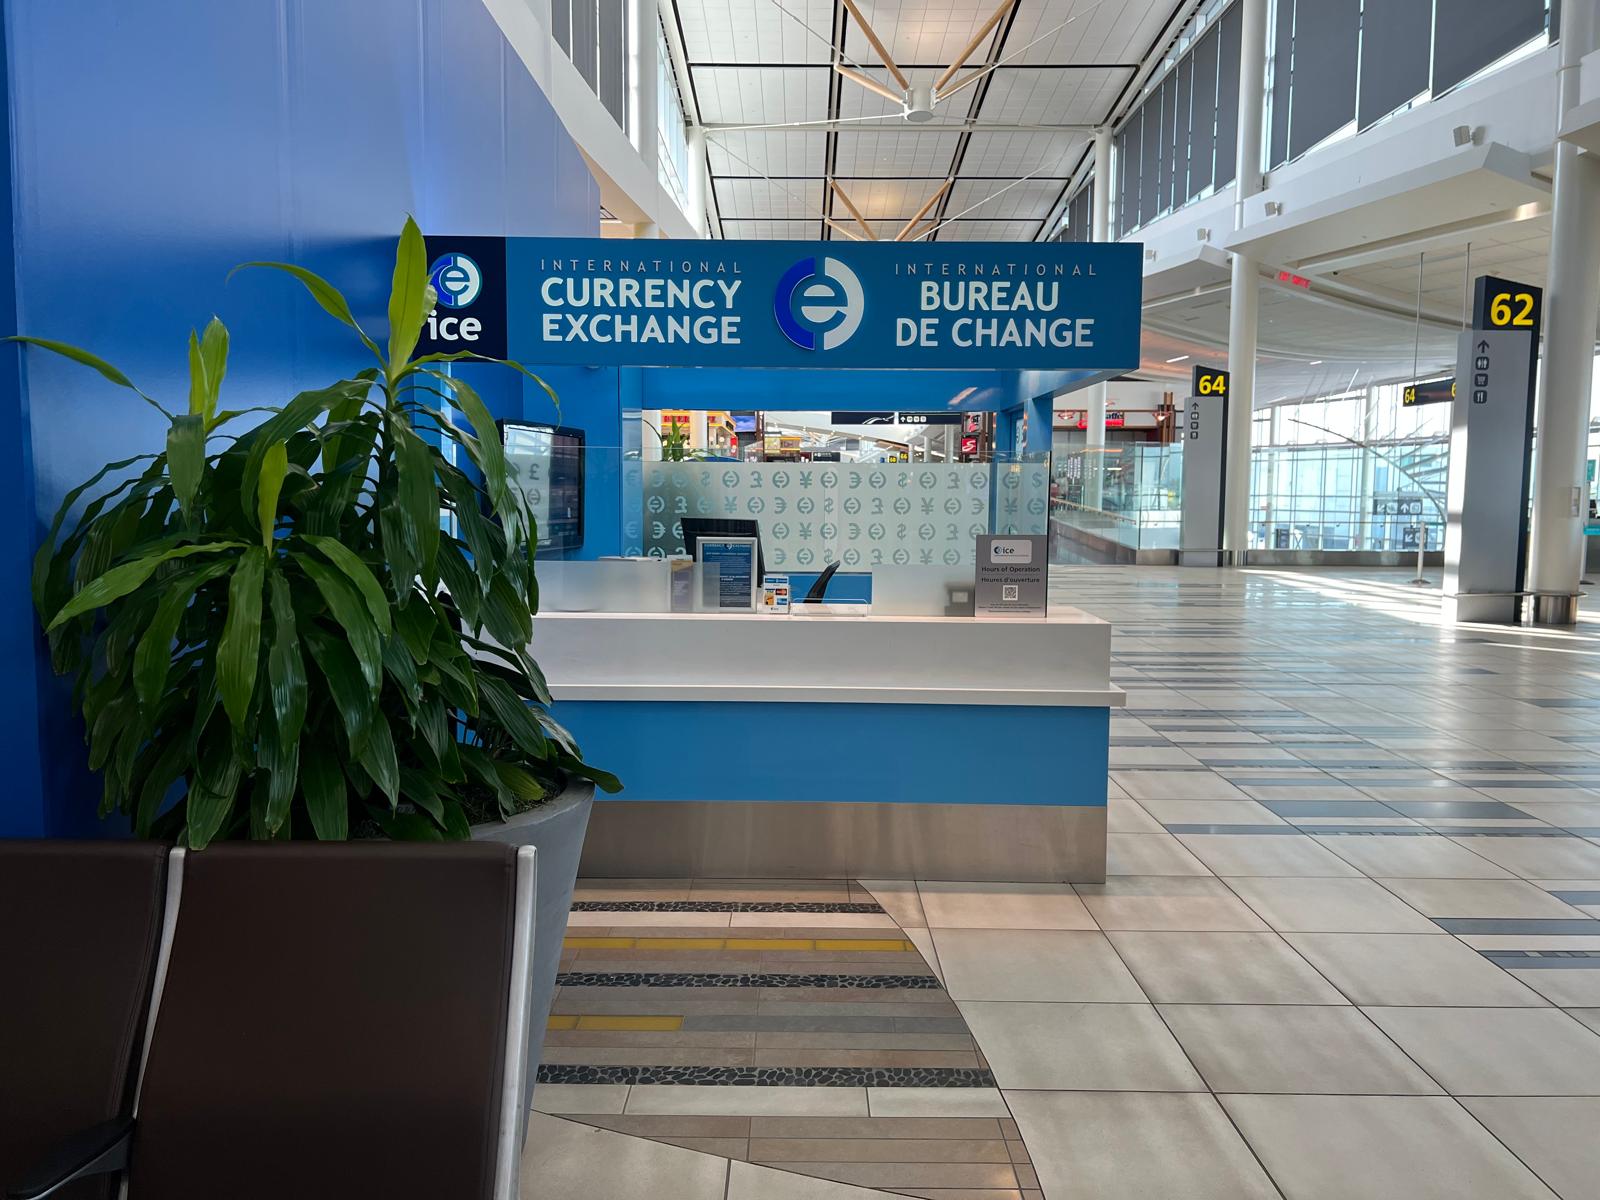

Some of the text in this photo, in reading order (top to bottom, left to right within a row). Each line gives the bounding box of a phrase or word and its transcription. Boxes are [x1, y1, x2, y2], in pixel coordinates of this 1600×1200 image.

[540, 258, 742, 274] INTERNATIONAL
[895, 263, 1097, 276] INTERNATIONAL
[540, 277, 742, 309] CURRENCY
[920, 281, 1059, 311] BUREAU
[1490, 293, 1534, 326] 62
[428, 310, 482, 341] ice
[542, 313, 741, 344] EXCHANGE
[896, 318, 1095, 348] DE CHANGE
[1198, 375, 1226, 395] 64
[1404, 388, 1415, 404] 64
[1002, 546, 1014, 554] ice
